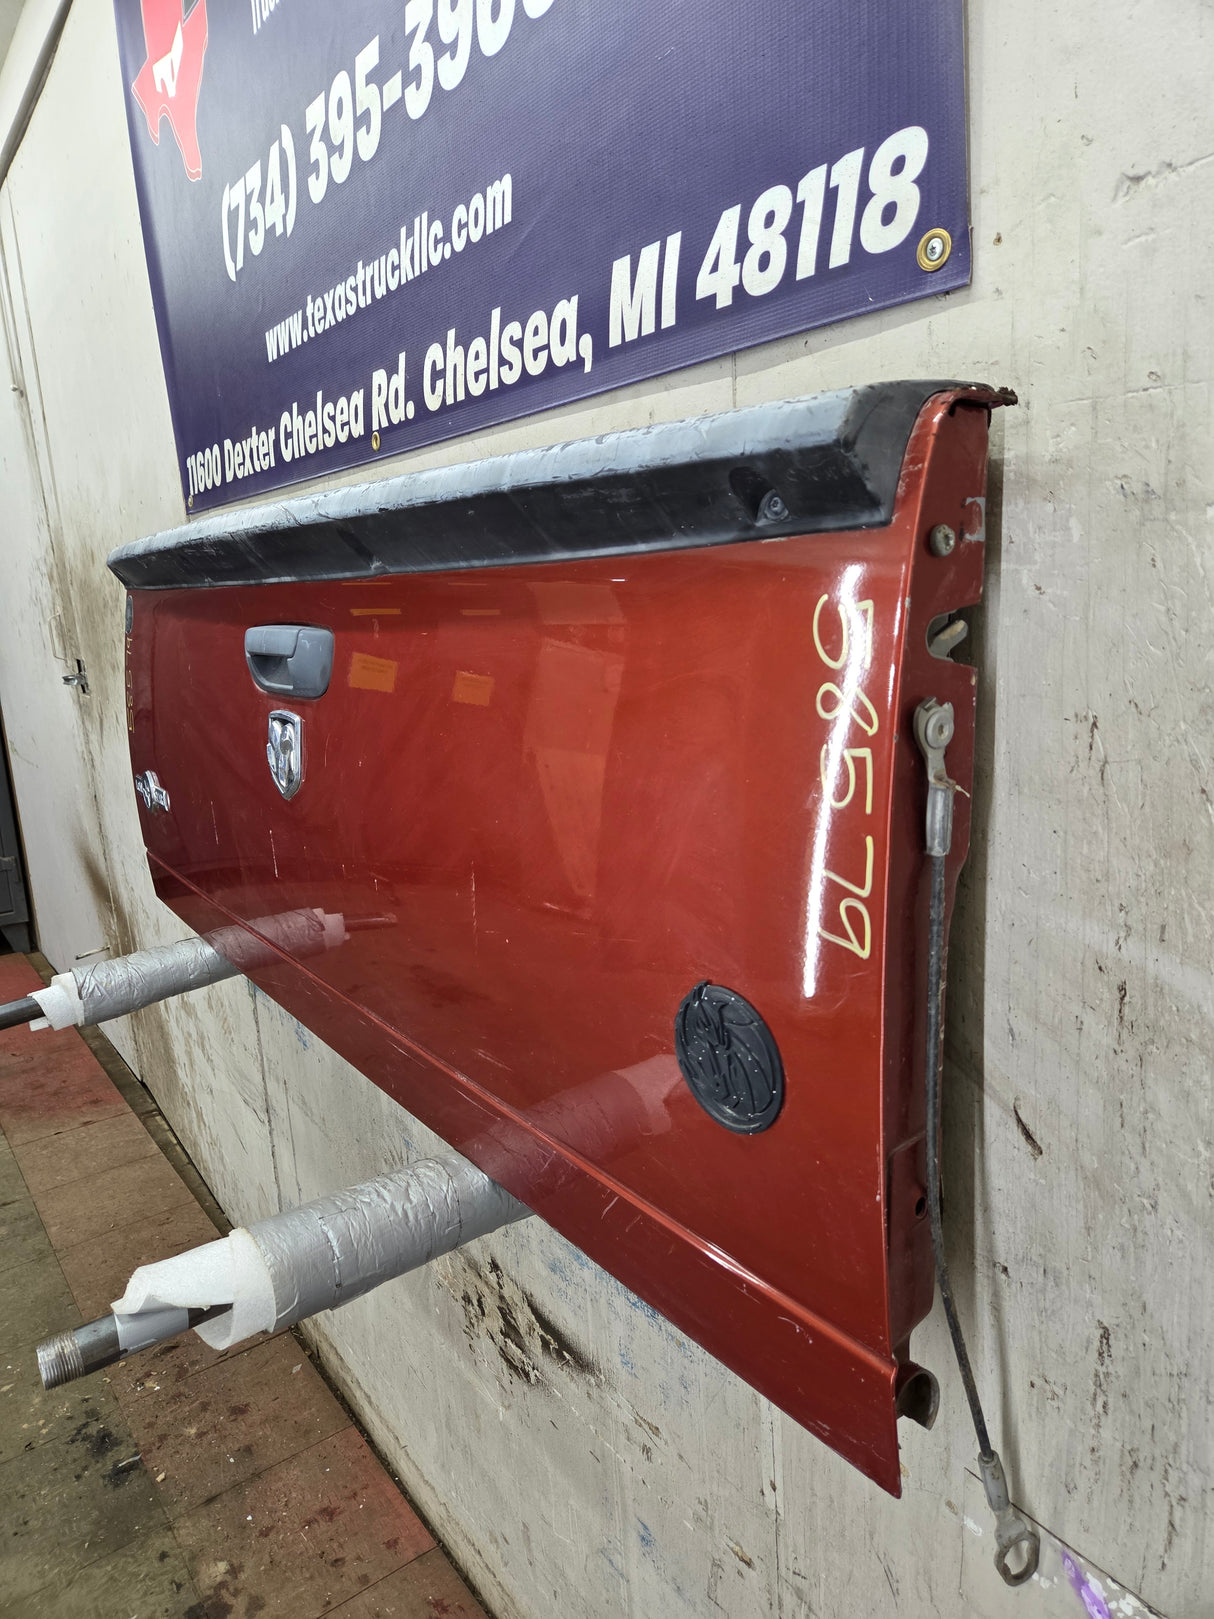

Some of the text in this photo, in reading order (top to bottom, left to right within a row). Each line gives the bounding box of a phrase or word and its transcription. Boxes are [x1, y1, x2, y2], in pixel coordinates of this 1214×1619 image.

[221, 0, 555, 282] (734) 395-39
[265, 173, 512, 362] www.texastruckllc.com
[186, 126, 929, 496] 11600 Dexter Chelsea Rd. Chelsea, MI 48118
